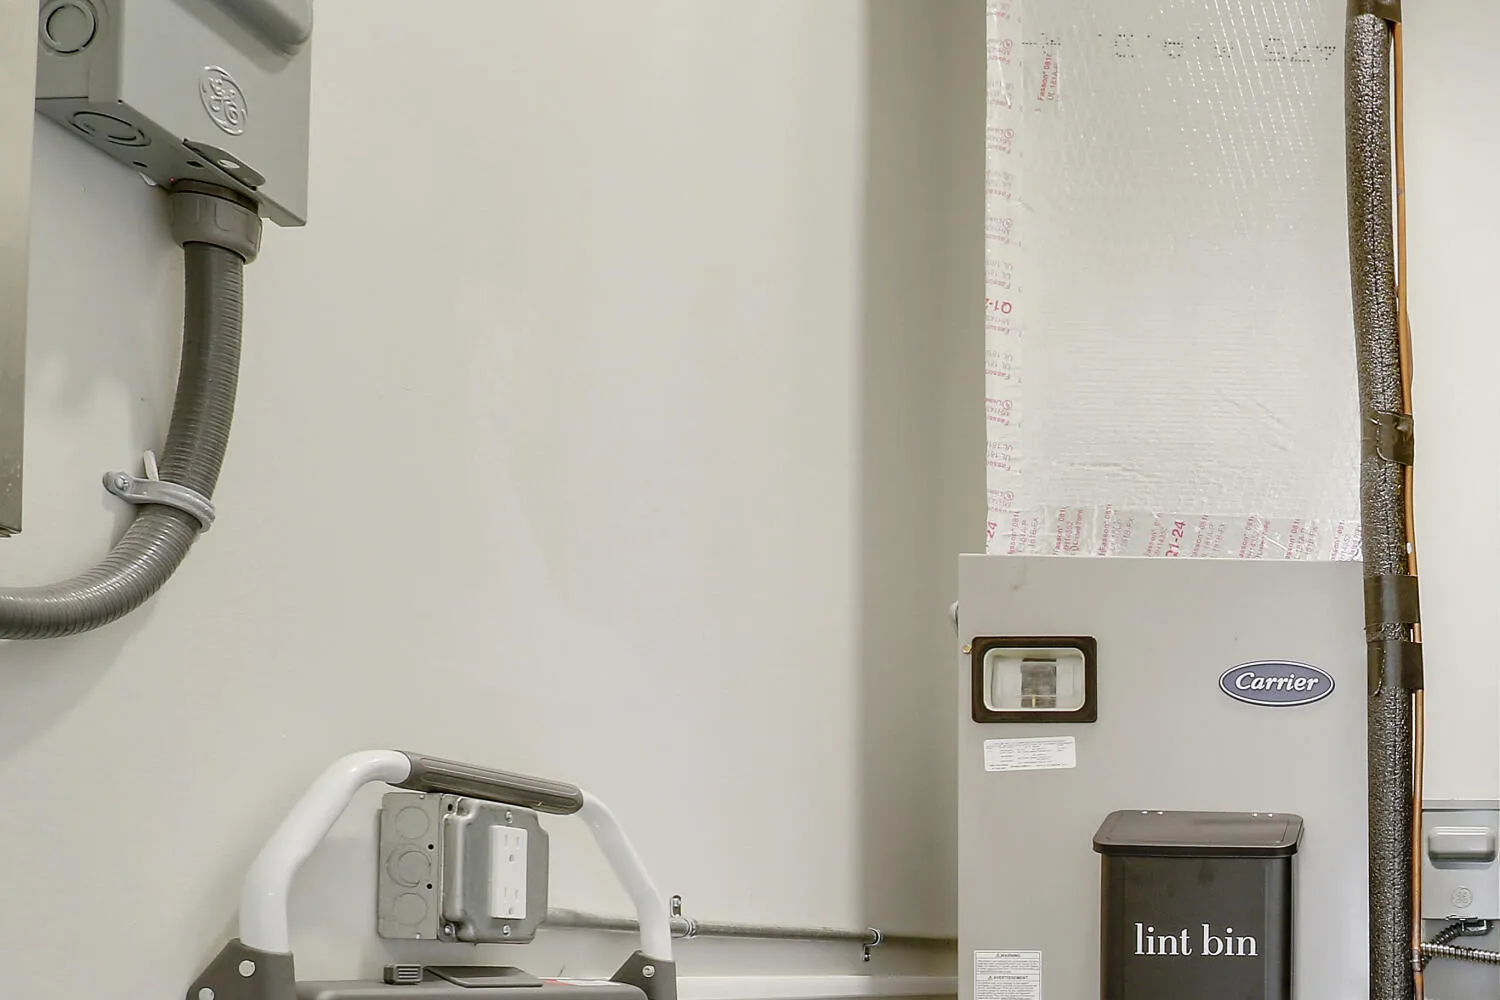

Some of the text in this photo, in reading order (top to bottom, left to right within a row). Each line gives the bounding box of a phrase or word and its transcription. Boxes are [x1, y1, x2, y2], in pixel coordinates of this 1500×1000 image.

[1235, 672, 1319, 691] Carrier
[1134, 922, 1258, 956] lint bin
